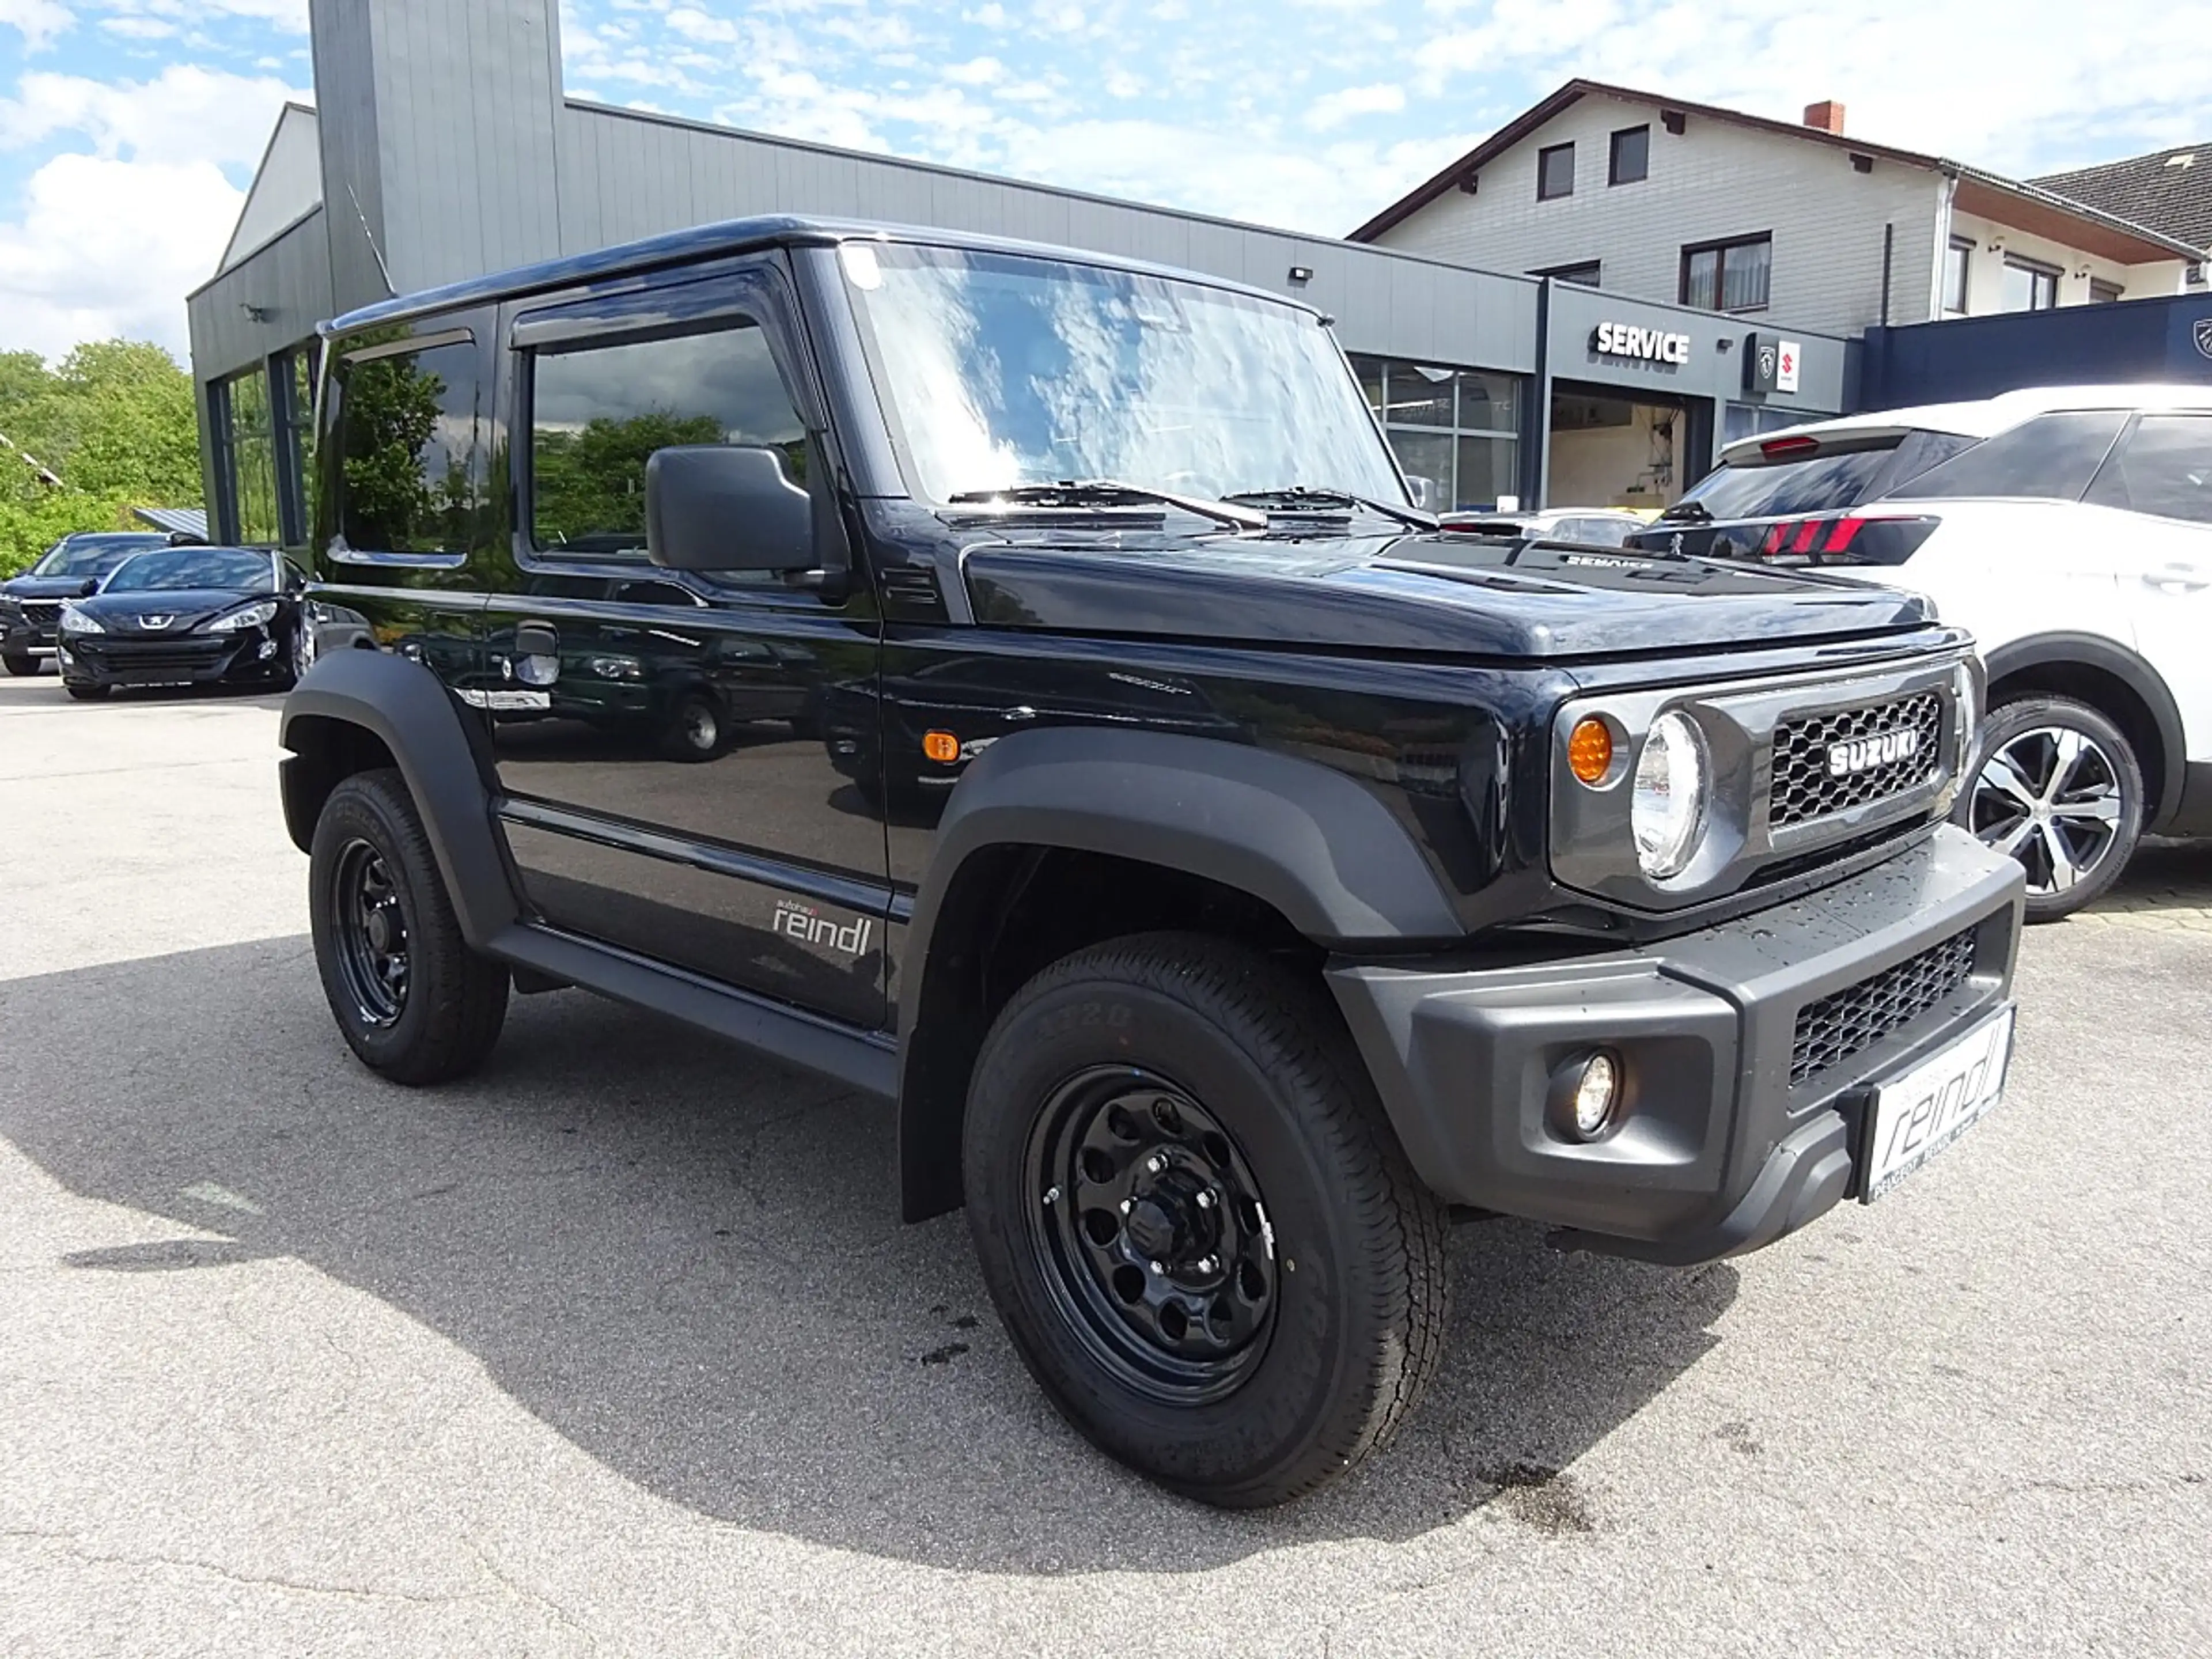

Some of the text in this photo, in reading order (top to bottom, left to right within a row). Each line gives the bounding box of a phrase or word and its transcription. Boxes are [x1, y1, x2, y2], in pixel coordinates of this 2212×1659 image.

[1597, 322, 1690, 365] SERVICE
[1829, 729, 1917, 776] SUZUKI
[772, 908, 872, 956] reindl
